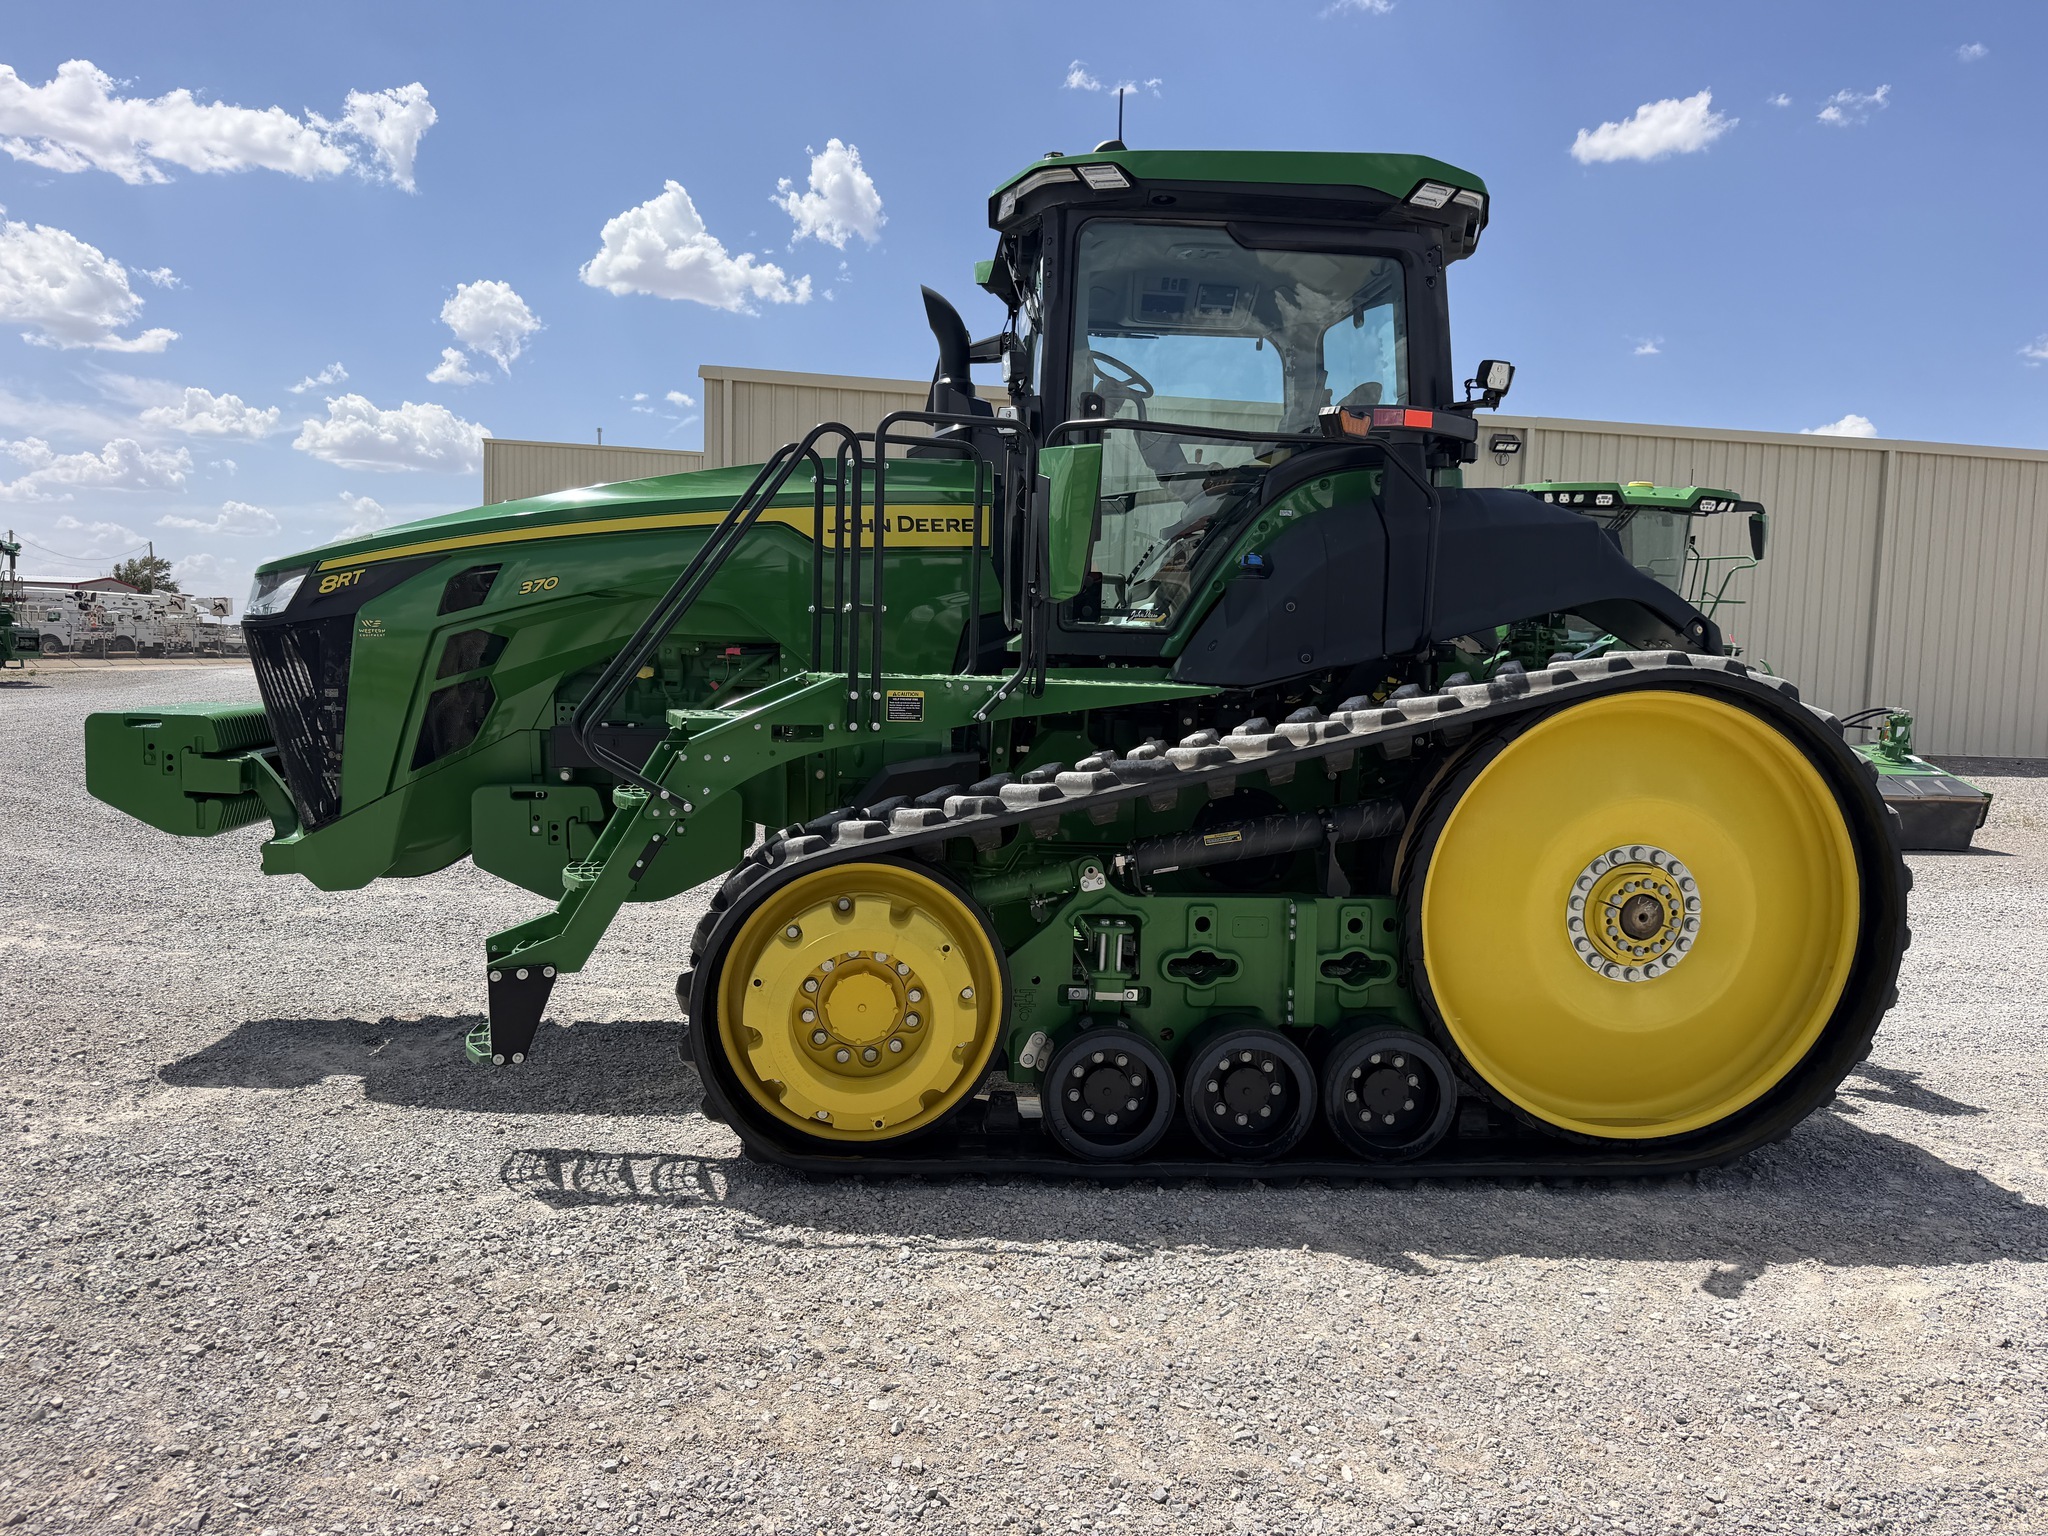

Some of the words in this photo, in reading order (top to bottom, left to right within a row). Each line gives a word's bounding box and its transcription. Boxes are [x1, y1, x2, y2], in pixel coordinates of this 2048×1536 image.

[897, 515, 974, 533] DEERE
[318, 568, 366, 594] 8RT
[519, 576, 559, 595] 370
